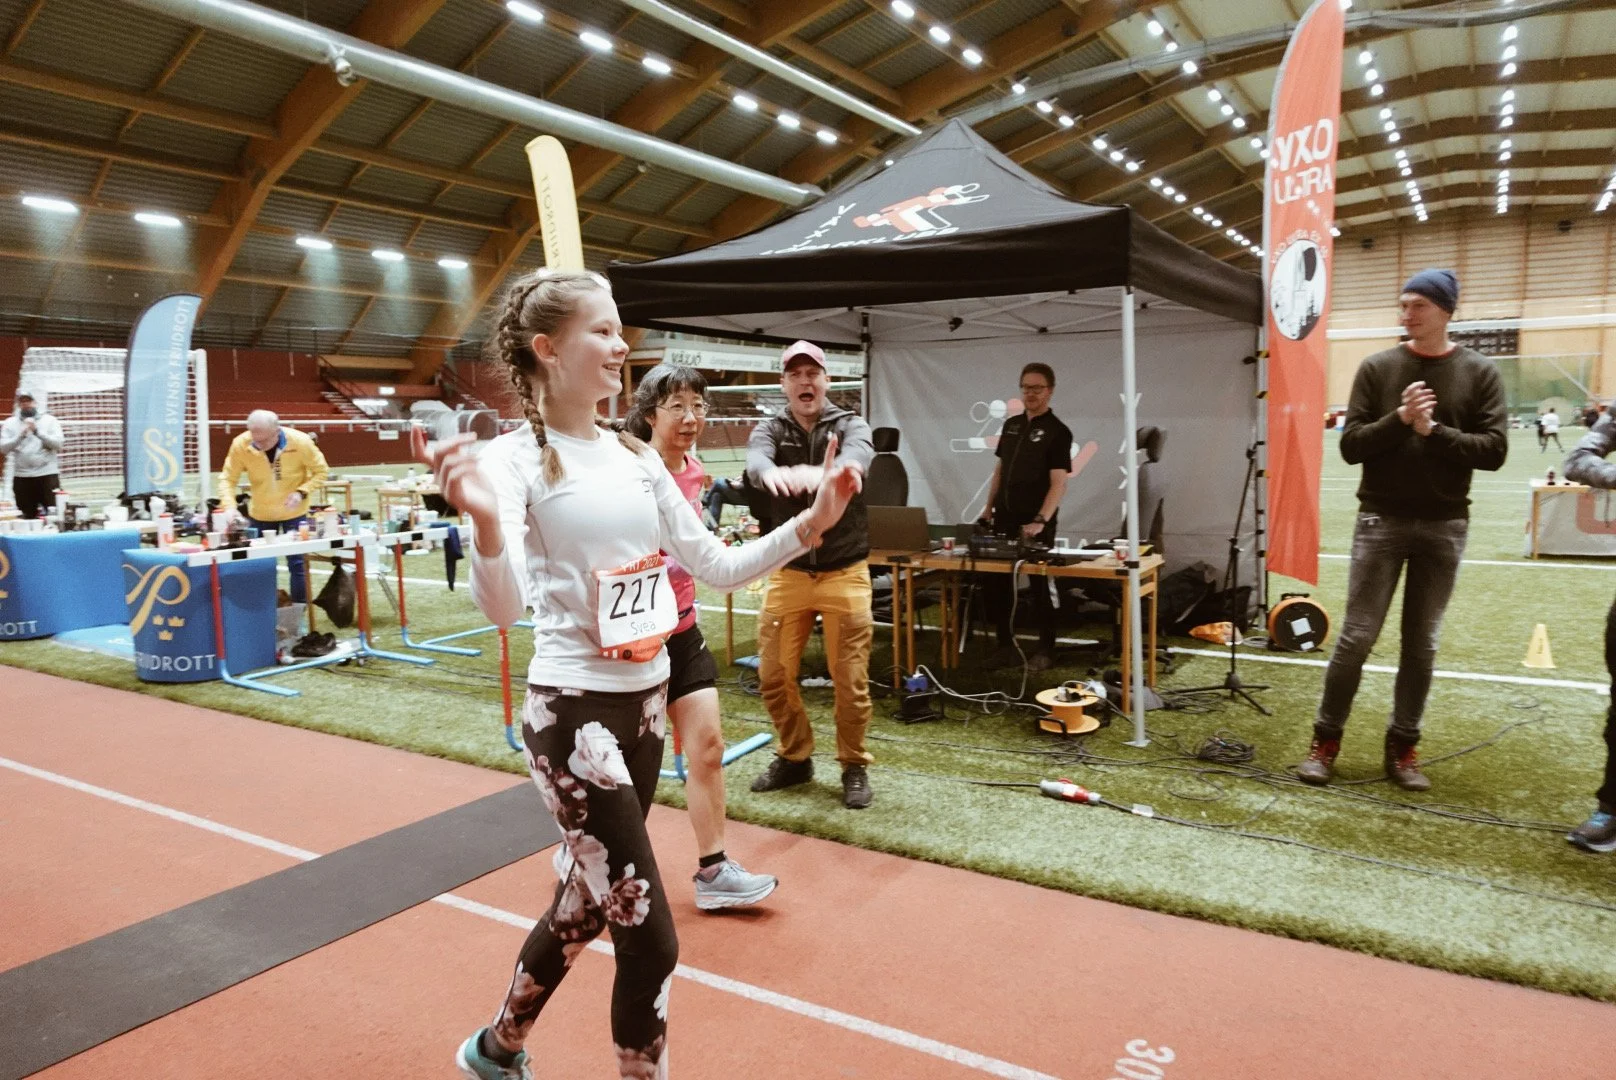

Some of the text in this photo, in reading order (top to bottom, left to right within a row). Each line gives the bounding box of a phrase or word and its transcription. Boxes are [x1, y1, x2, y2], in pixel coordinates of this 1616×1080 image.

[1274, 163, 1333, 205] ULTRA
[165, 300, 193, 425] SVENSK FRIIDROTT
[609, 572, 661, 620] 227
[630, 620, 657, 636] Svea
[1105, 1038, 1176, 1080] 30
